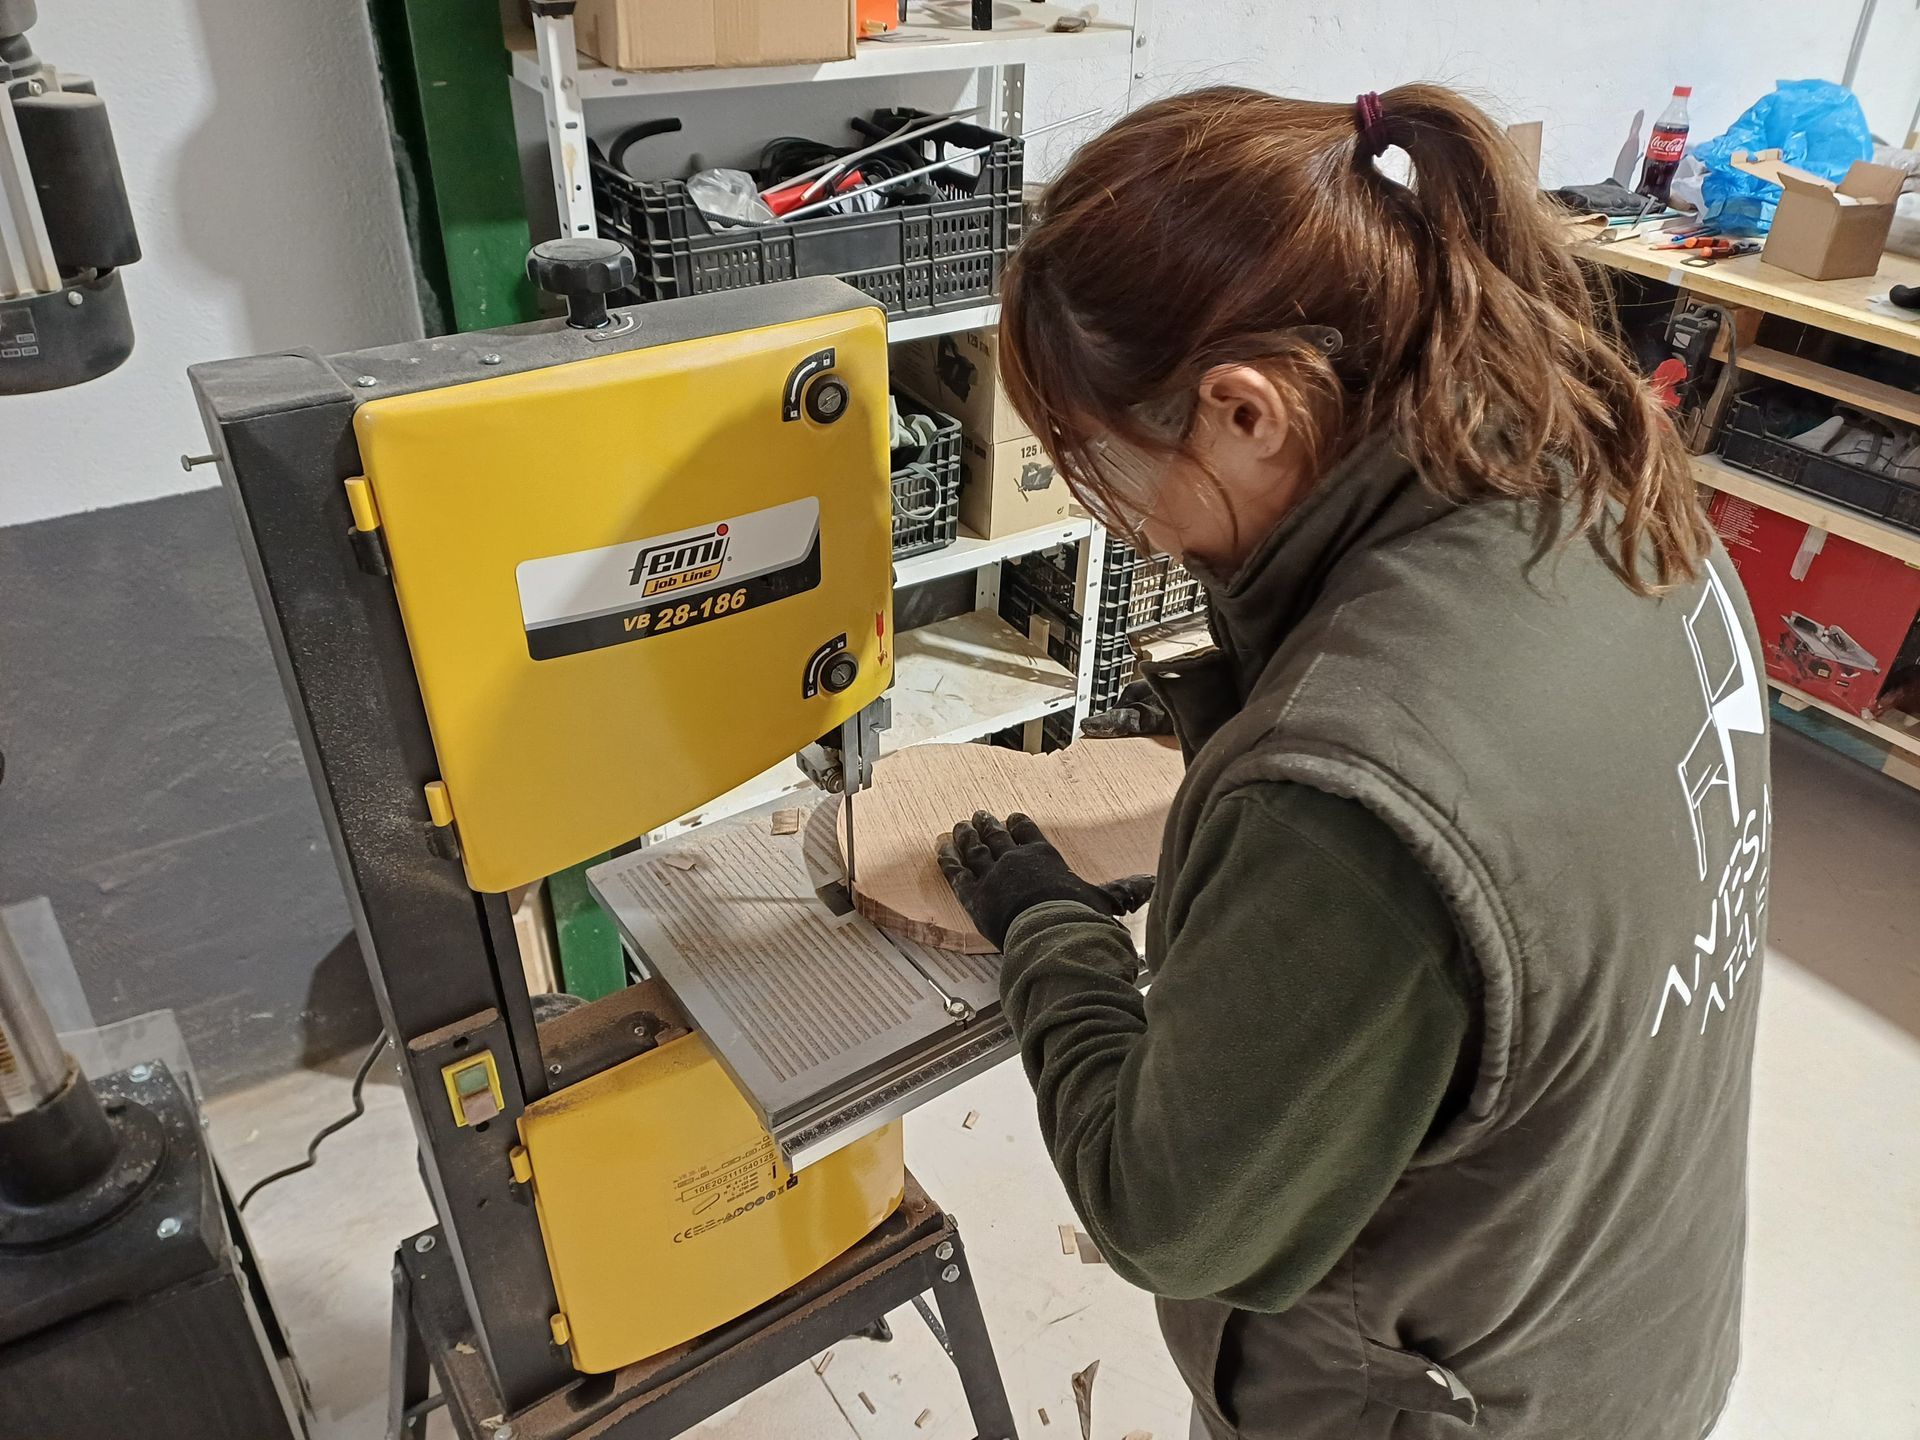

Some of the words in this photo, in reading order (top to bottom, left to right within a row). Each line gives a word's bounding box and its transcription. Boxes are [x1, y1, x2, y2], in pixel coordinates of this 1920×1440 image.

[1021, 444, 1037, 459] 125
[623, 613, 651, 632] VB
[654, 588, 747, 631] 28-186
